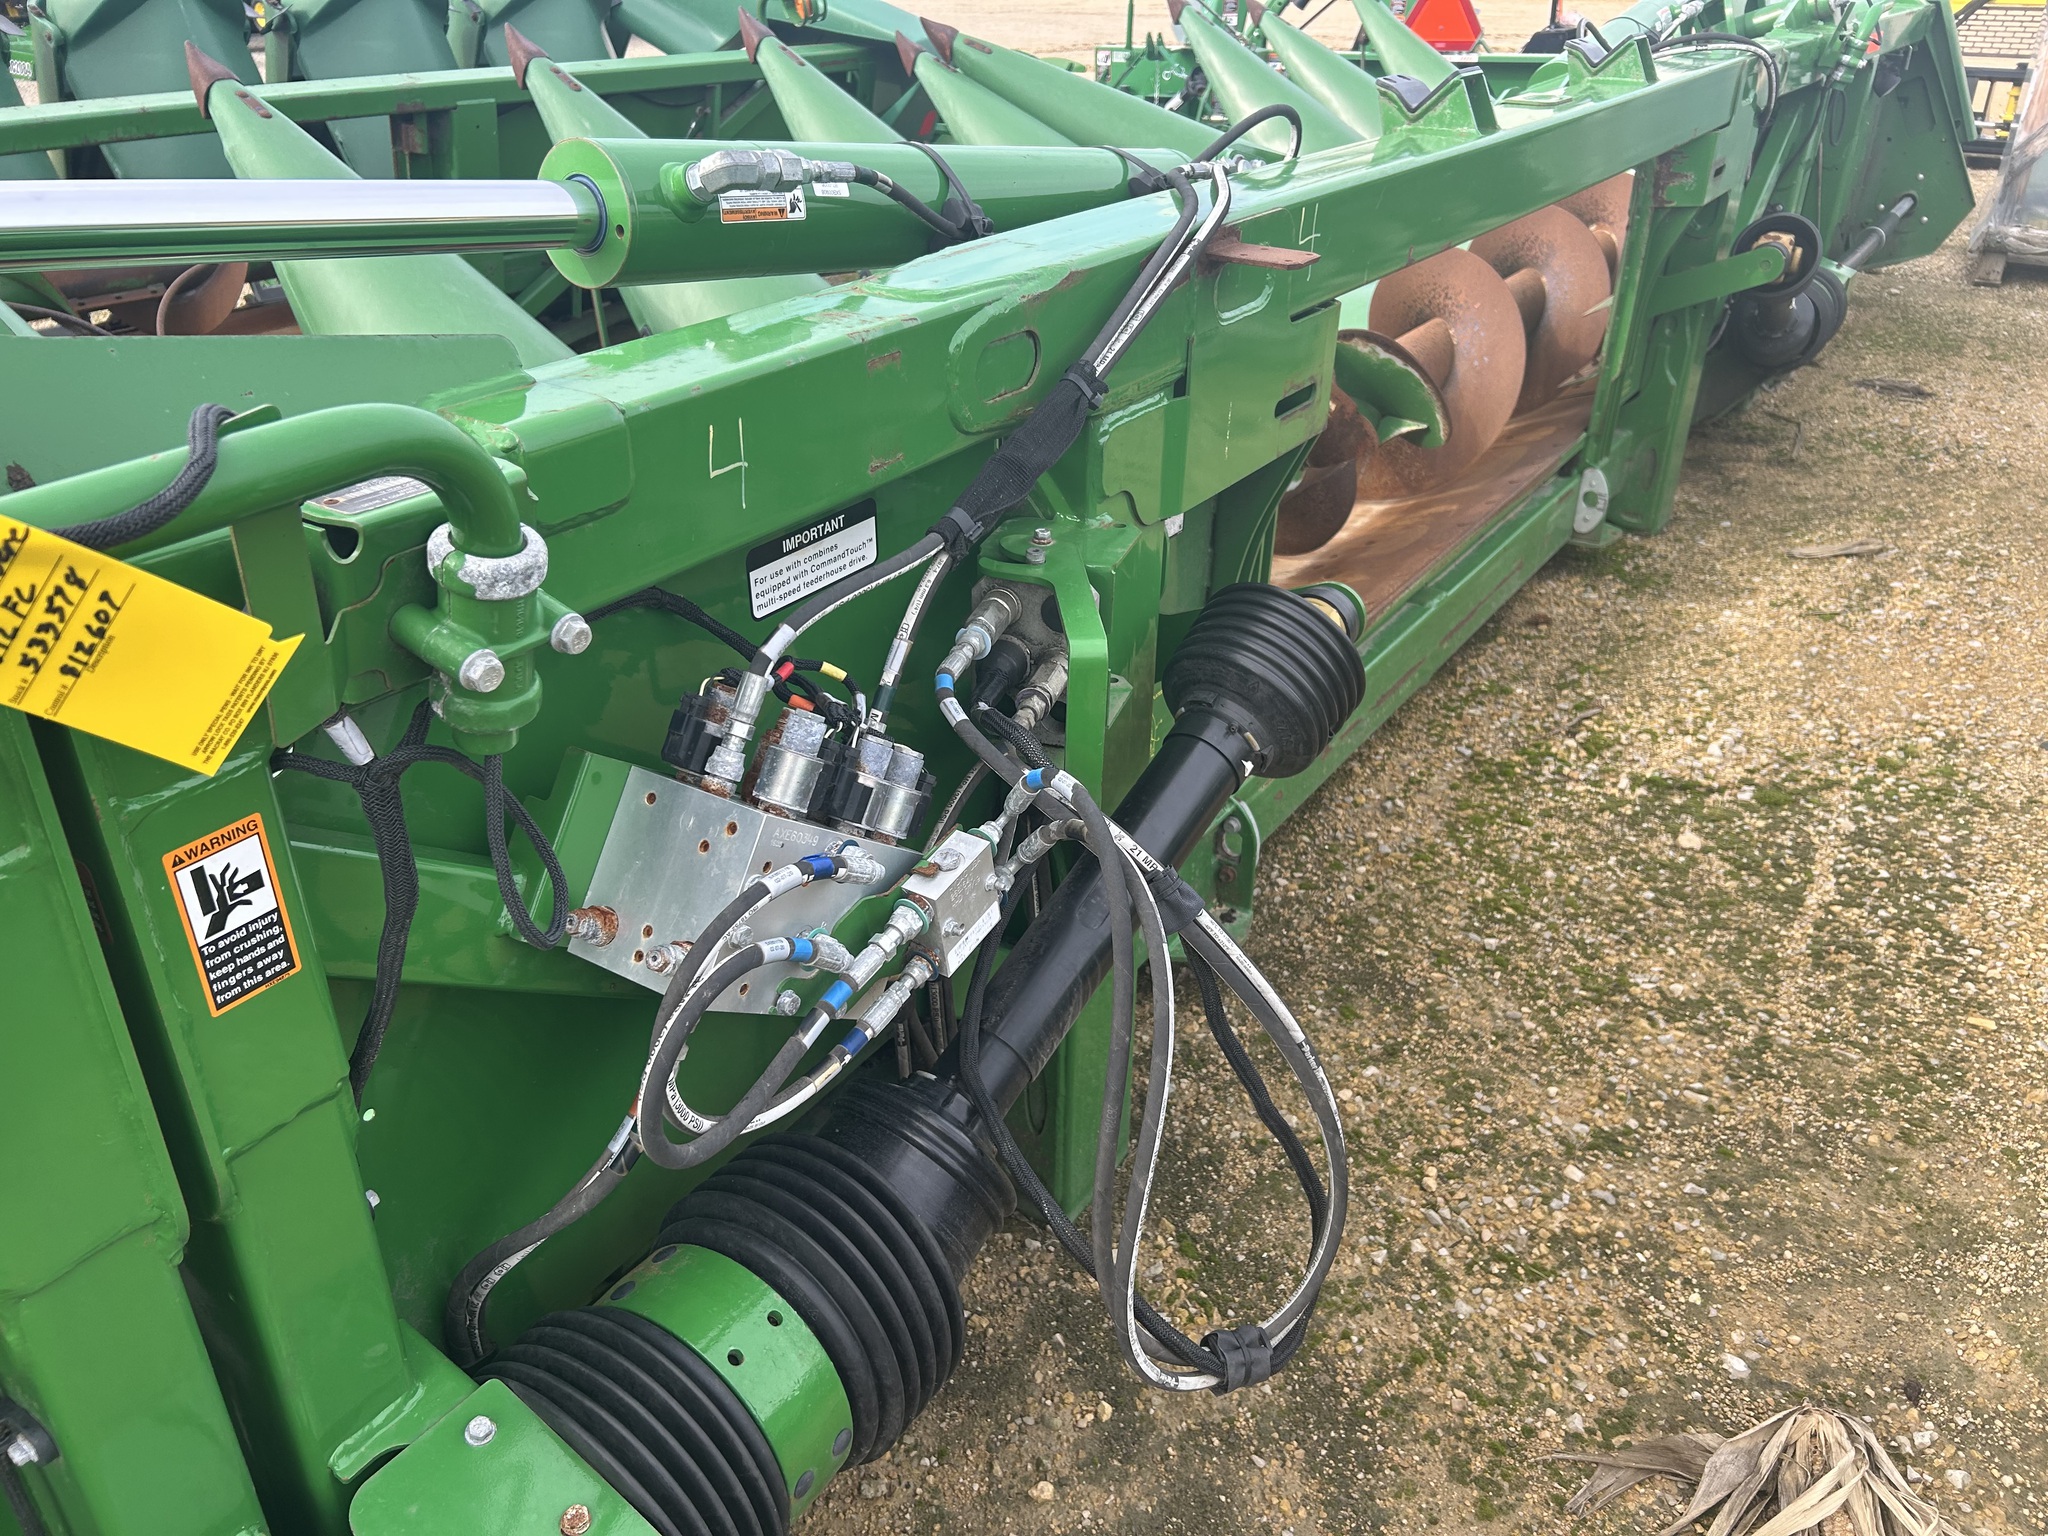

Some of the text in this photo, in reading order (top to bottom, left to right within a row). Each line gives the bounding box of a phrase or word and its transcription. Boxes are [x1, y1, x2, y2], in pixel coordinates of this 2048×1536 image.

[1299, 203, 1321, 282] 4
[709, 417, 748, 510] 4
[782, 515, 845, 553] IMPORTANT
[754, 543, 838, 588] For use with combines
[755, 576, 791, 600] equipped
[793, 567, 809, 582] with
[757, 553, 868, 612] multi-speed feederhouse drive.
[88, 635, 116, 674] Description
[45, 690, 67, 716] Control
[184, 819, 258, 860] WARNING
[772, 827, 820, 846] AXE60349
[1128, 843, 1144, 858] 21
[201, 911, 279, 956] To avoid injury
[205, 925, 283, 968] from crushing,
[721, 912, 749, 944] 18752-AC
[209, 935, 285, 980] keep hands and
[213, 949, 285, 992] fingers away
[216, 961, 290, 1004] from this area.
[1301, 1045, 1319, 1071] Parker
[686, 1115, 705, 1134] PSI)
